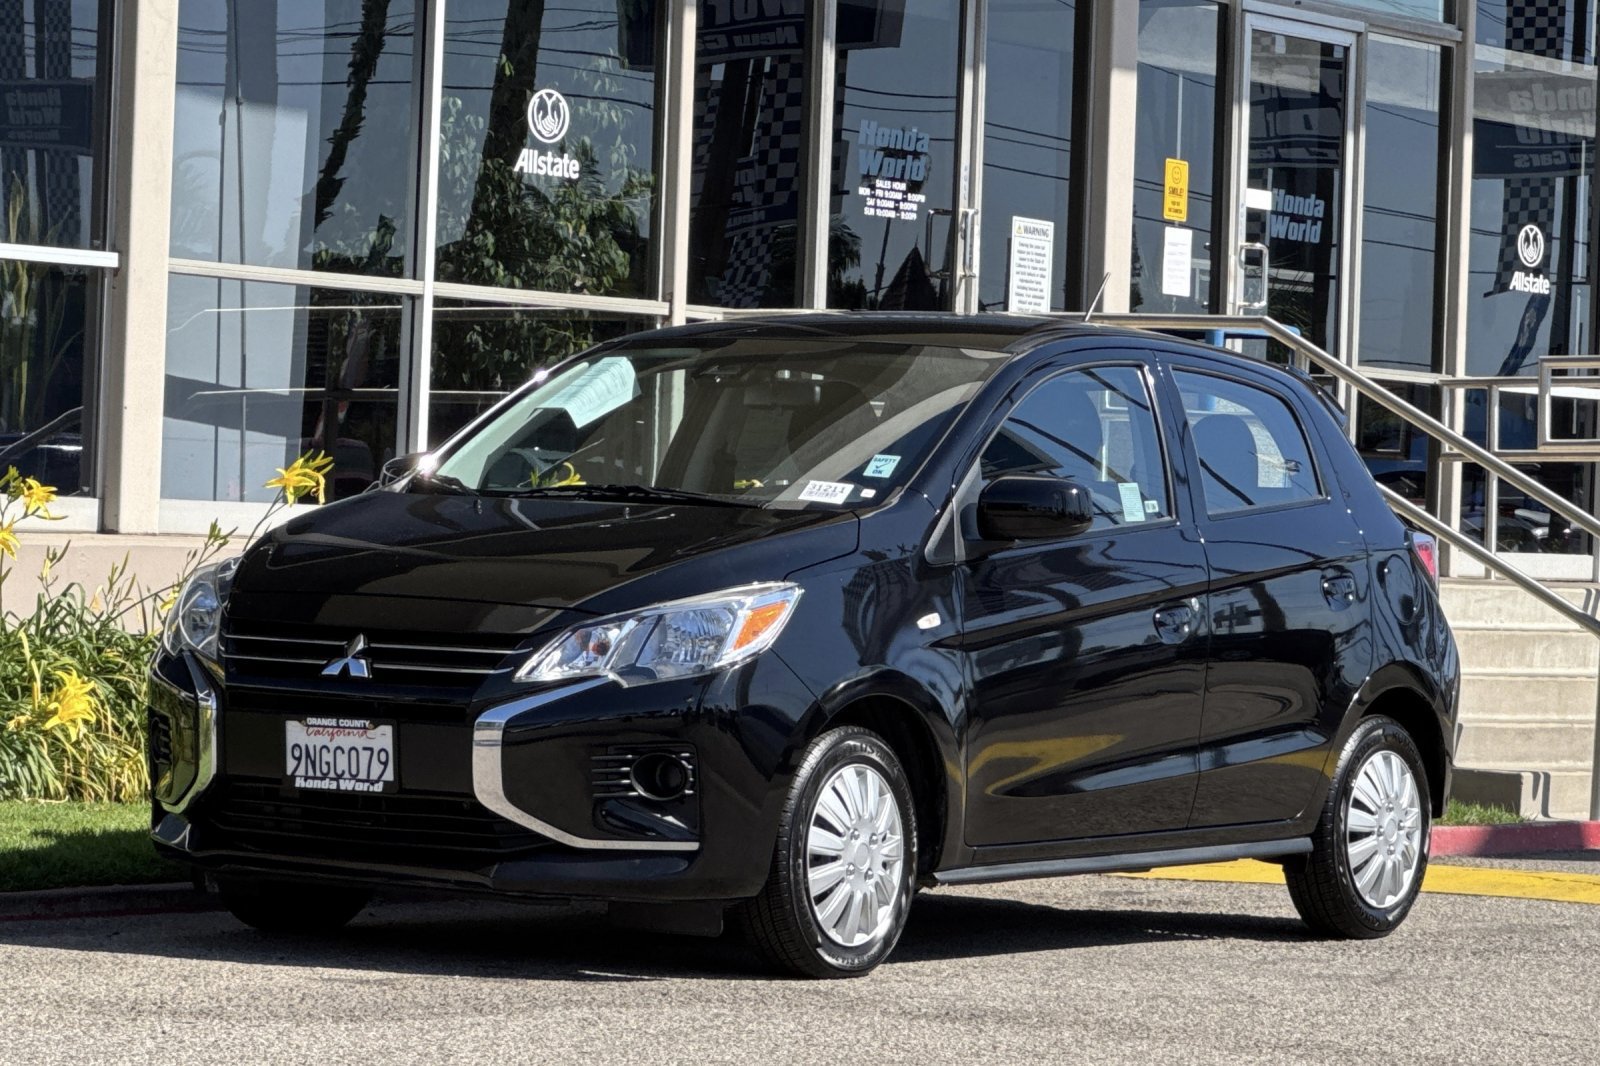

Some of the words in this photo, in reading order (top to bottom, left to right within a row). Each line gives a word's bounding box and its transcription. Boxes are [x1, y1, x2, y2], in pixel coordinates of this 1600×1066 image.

[859, 120, 929, 153] Honda
[513, 148, 580, 180] Allstate
[859, 149, 927, 181] World
[876, 180, 891, 189] SALES
[1271, 188, 1325, 218] Honda
[1023, 225, 1050, 239] WARNING
[1270, 214, 1322, 244] World
[1509, 271, 1551, 294] Allstate
[305, 726, 377, 742] California
[306, 717, 338, 727] ORANGE
[339, 719, 371, 728] COUNTY
[290, 743, 390, 781] 9NGC079
[295, 776, 337, 790] Honda
